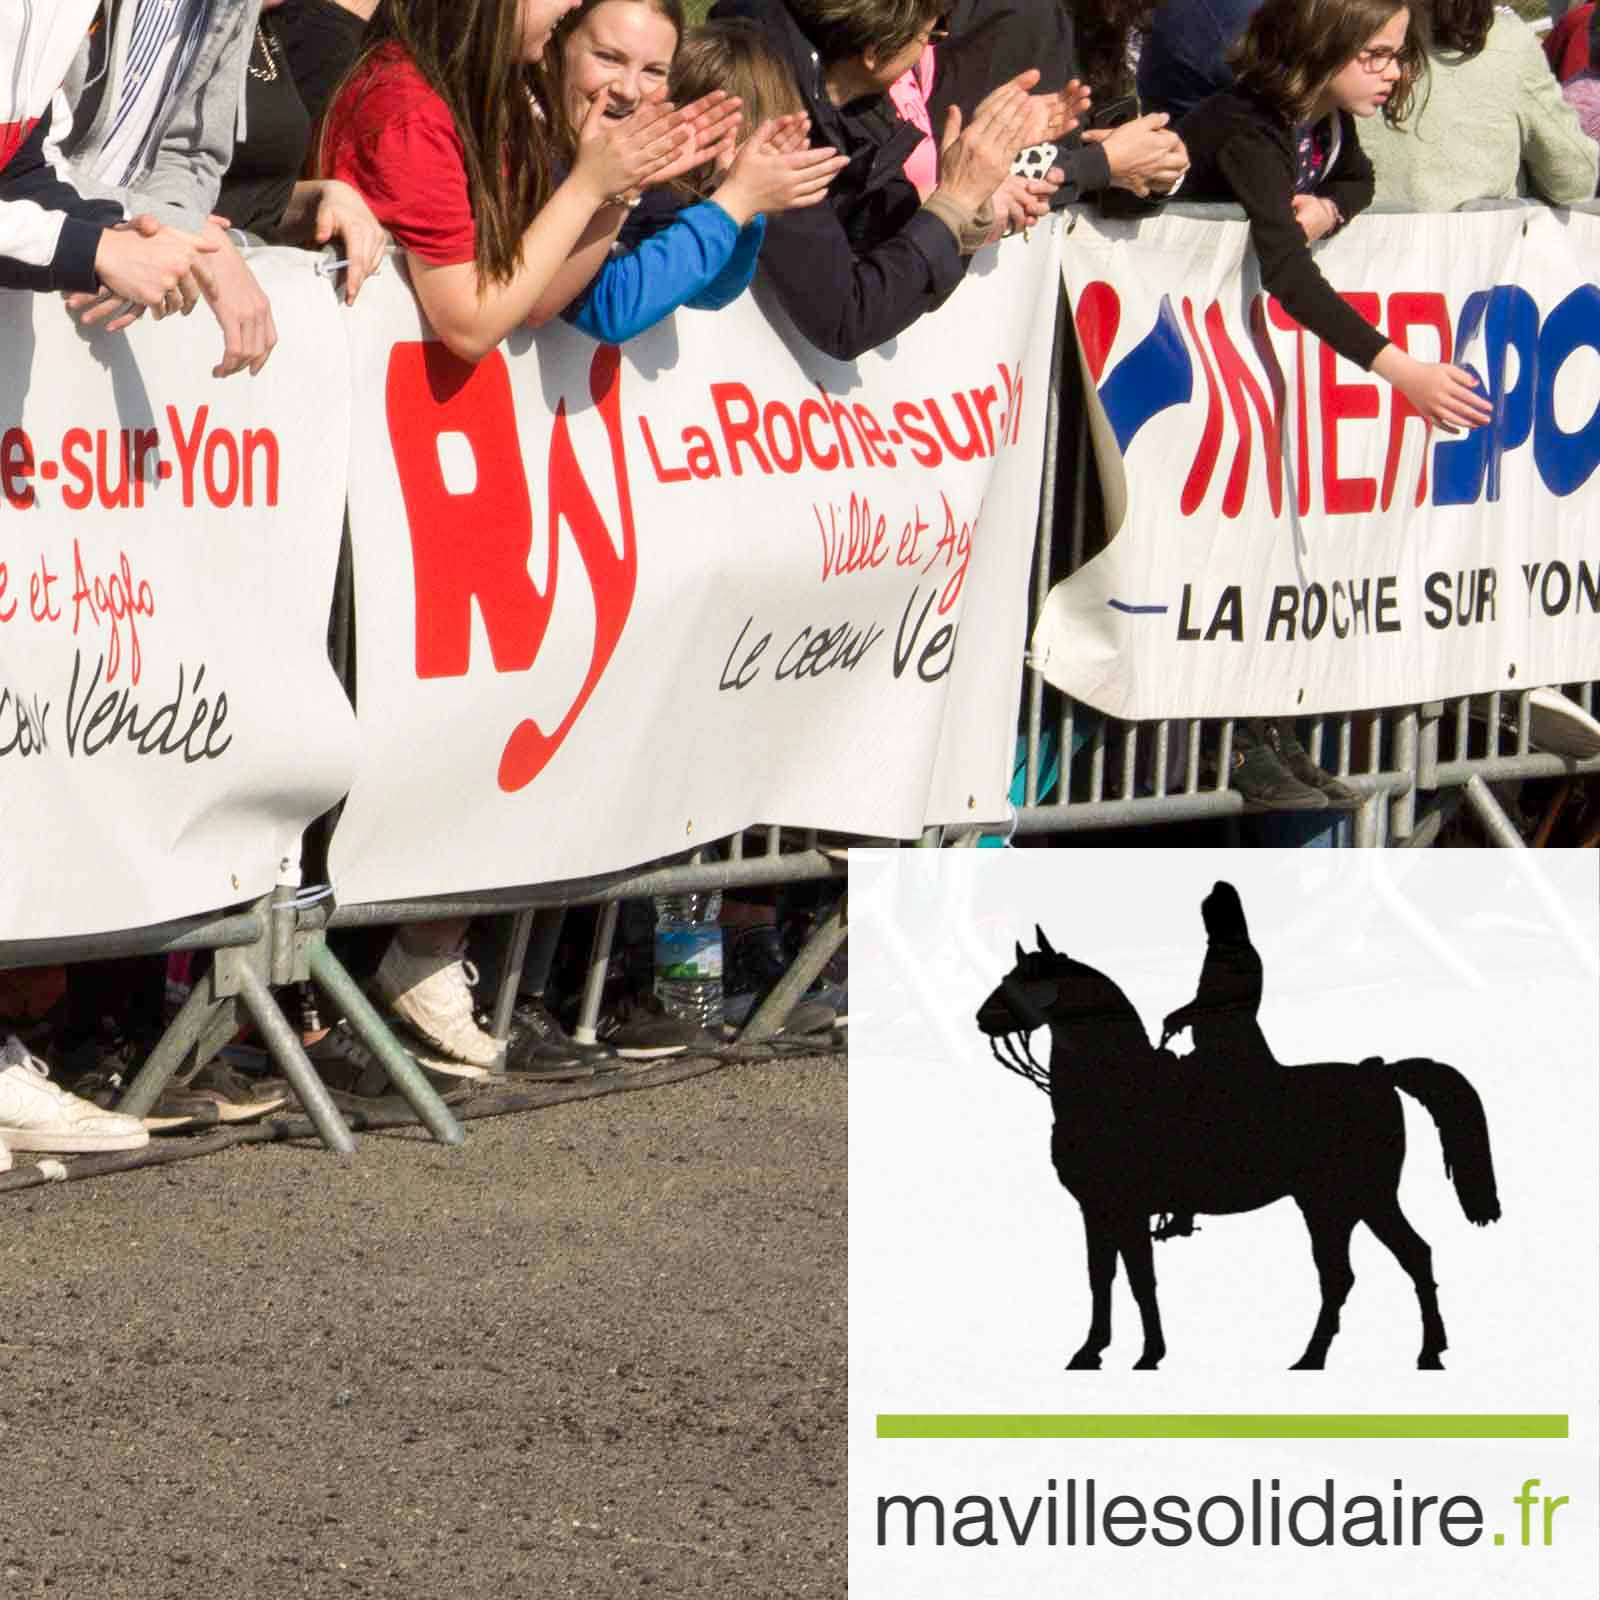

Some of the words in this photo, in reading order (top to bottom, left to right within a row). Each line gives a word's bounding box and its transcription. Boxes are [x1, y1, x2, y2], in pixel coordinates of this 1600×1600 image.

[812, 491, 889, 584] Ville
[896, 504, 928, 568] et
[30, 552, 61, 623] et
[1177, 582, 1244, 642] LA
[1266, 574, 1402, 643] ROCHE
[1424, 566, 1498, 631] SUR
[1522, 558, 1600, 617] YON
[718, 615, 769, 691] Le
[65, 648, 234, 764] Vendée
